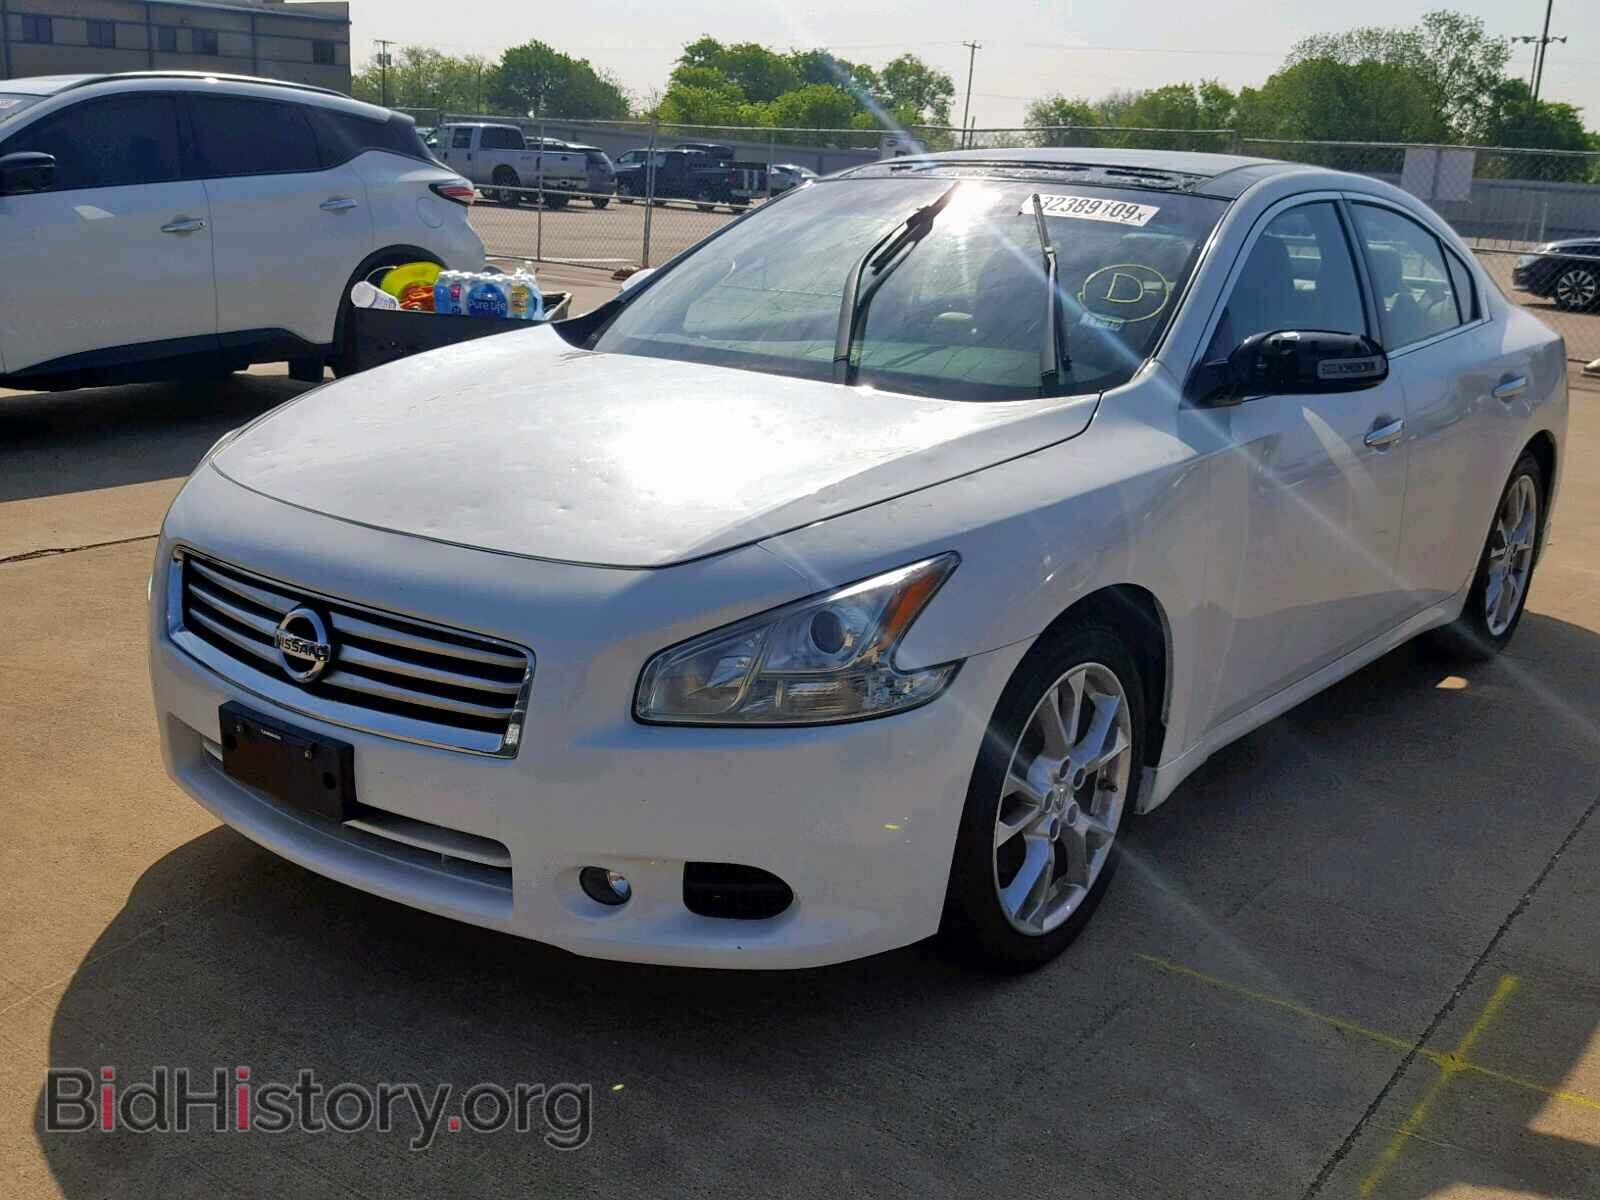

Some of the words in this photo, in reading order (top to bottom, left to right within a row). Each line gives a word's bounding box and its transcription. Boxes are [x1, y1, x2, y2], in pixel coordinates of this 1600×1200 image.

[468, 300, 488, 311] Pure
[490, 300, 507, 314] Life
[275, 631, 321, 657] NISSAN
